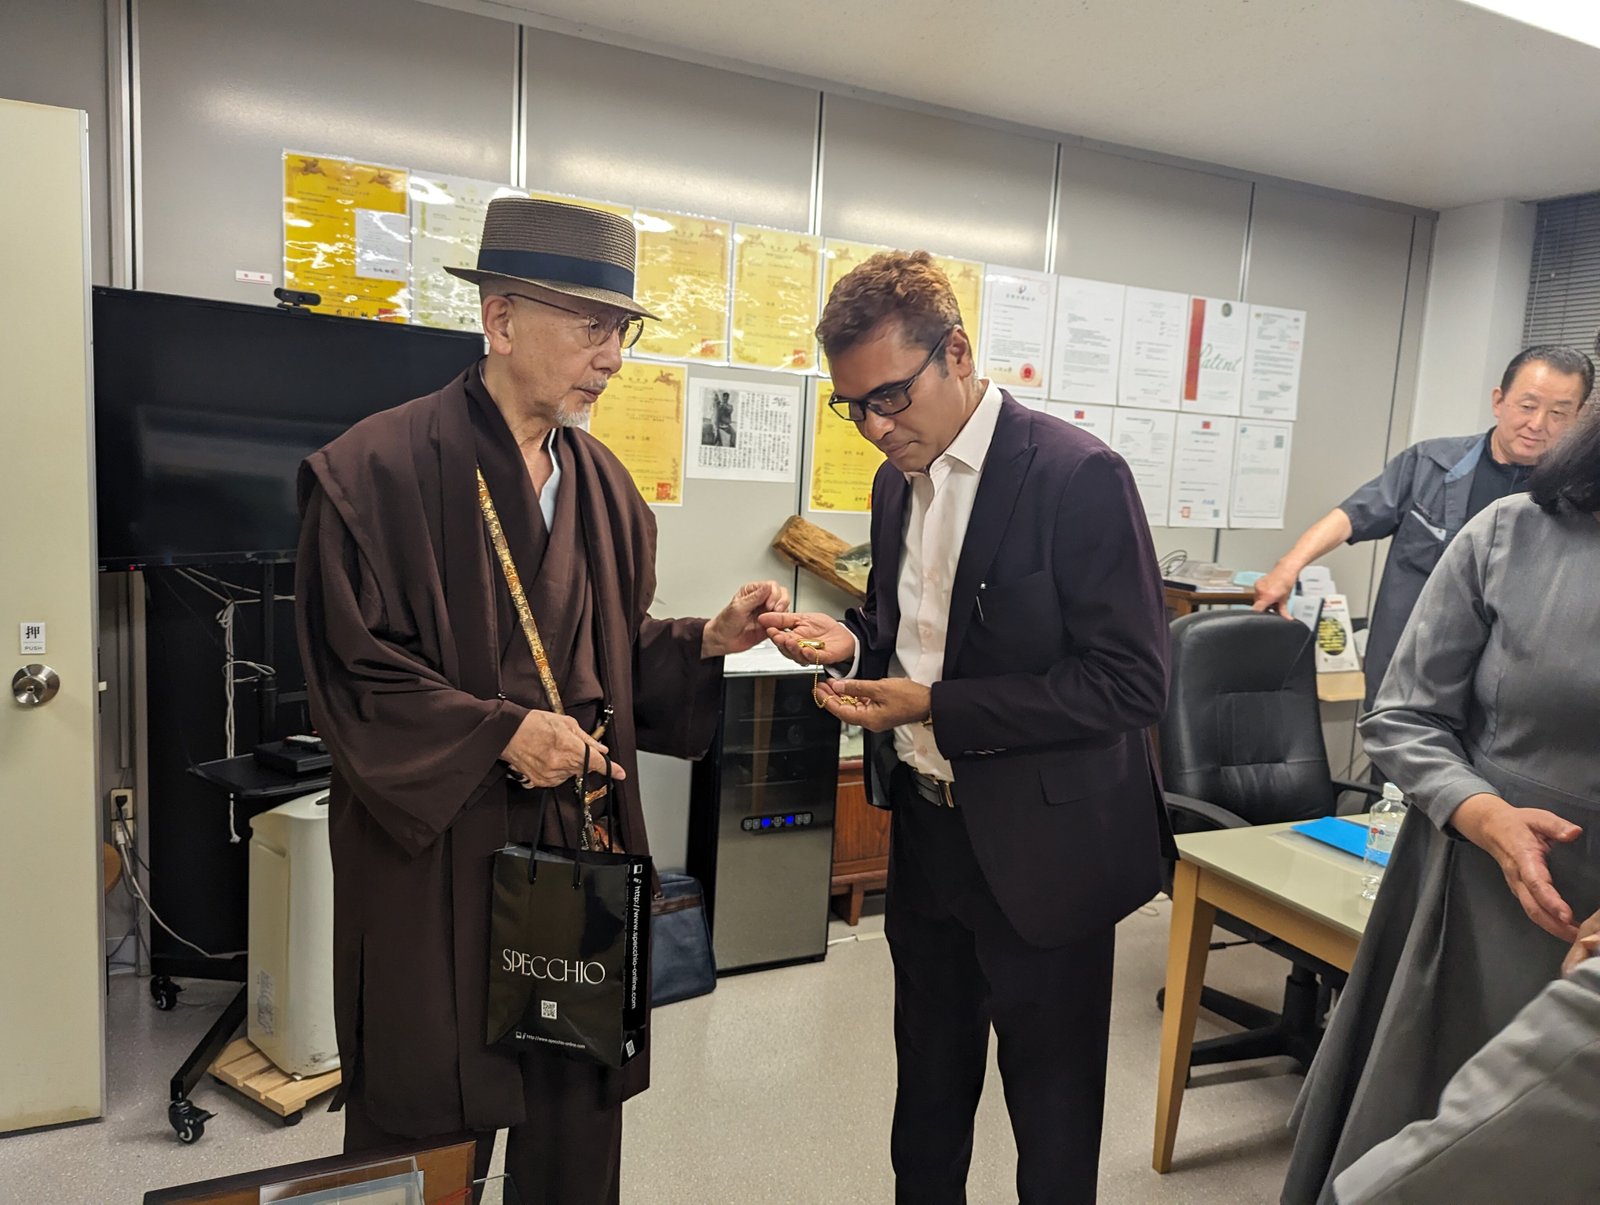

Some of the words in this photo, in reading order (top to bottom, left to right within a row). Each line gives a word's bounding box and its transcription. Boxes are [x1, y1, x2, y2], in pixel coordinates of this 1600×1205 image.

[1199, 343, 1242, 372] Patent
[25, 626, 40, 639] 押
[631, 885, 642, 1010] http://www.specchio-online.com
[502, 948, 606, 985] SPECCHIO
